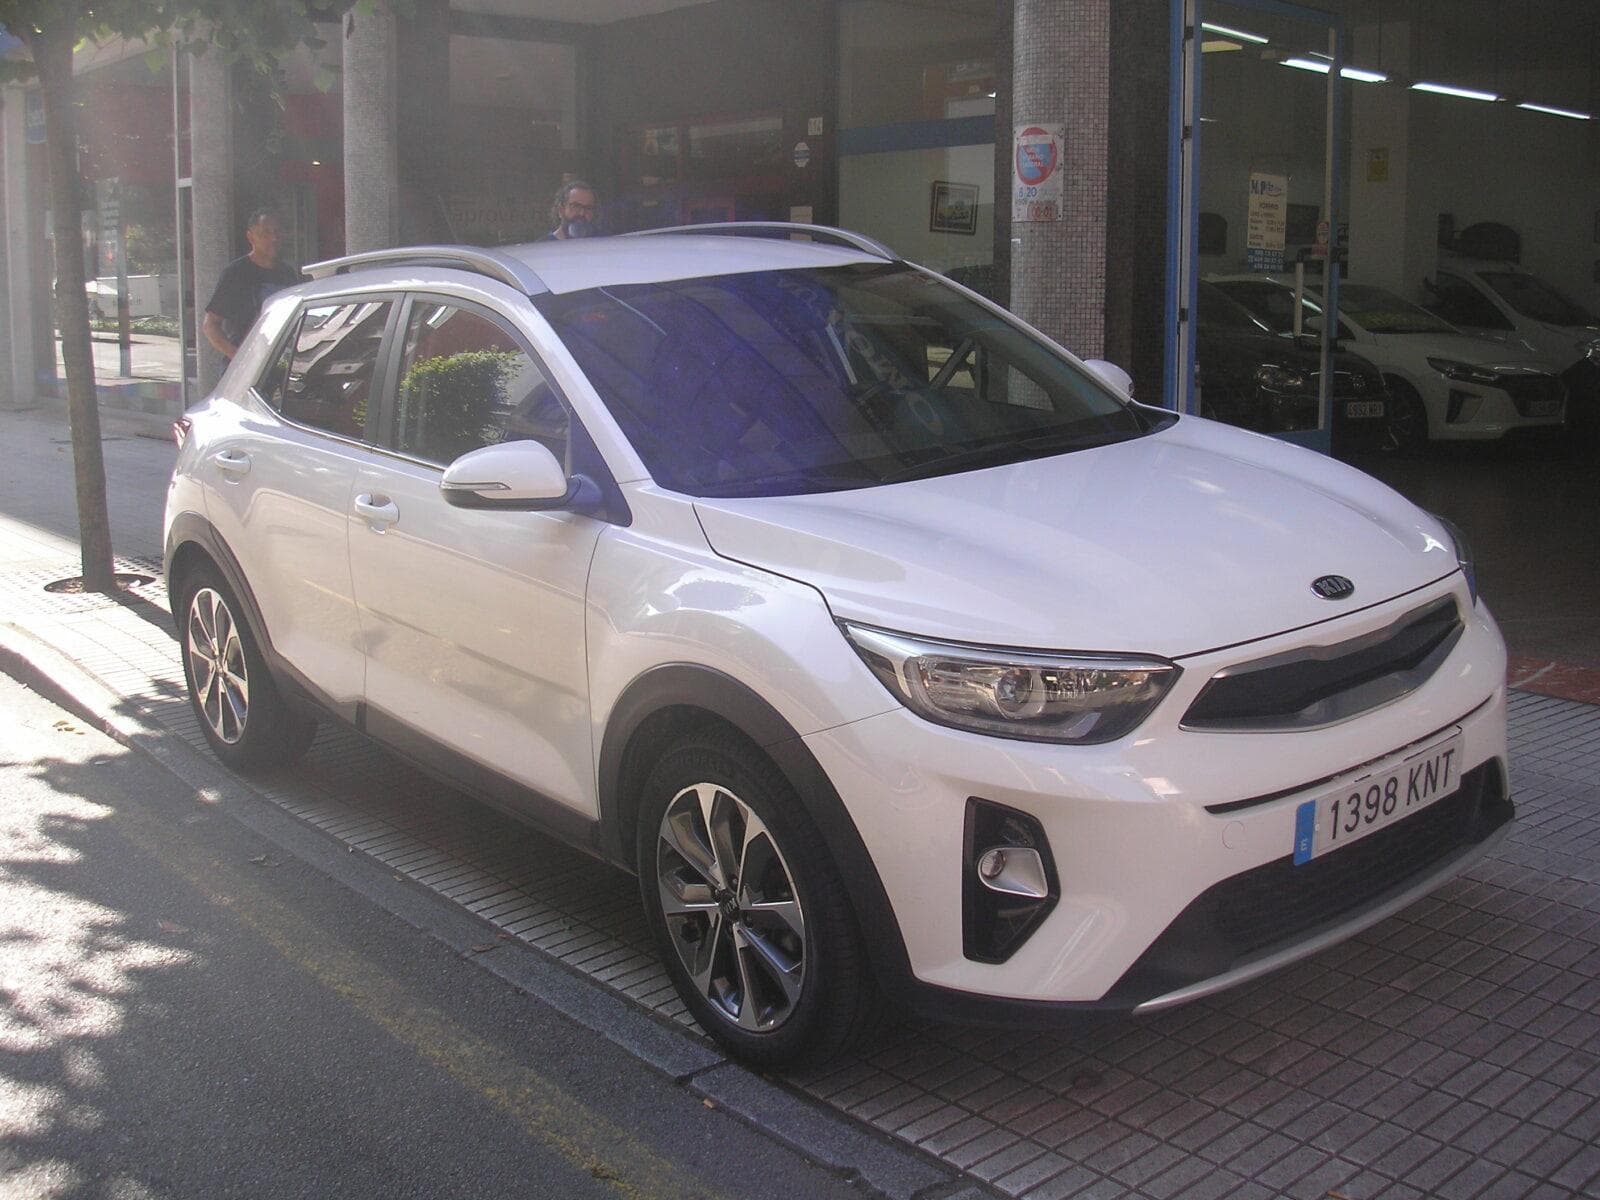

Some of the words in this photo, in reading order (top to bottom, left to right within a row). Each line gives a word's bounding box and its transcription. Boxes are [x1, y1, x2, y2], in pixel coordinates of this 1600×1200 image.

[1026, 186, 1038, 198] 20
[1315, 577, 1352, 596] KIA
[1331, 776, 1398, 840] 1398
[1407, 749, 1455, 806] KNT
